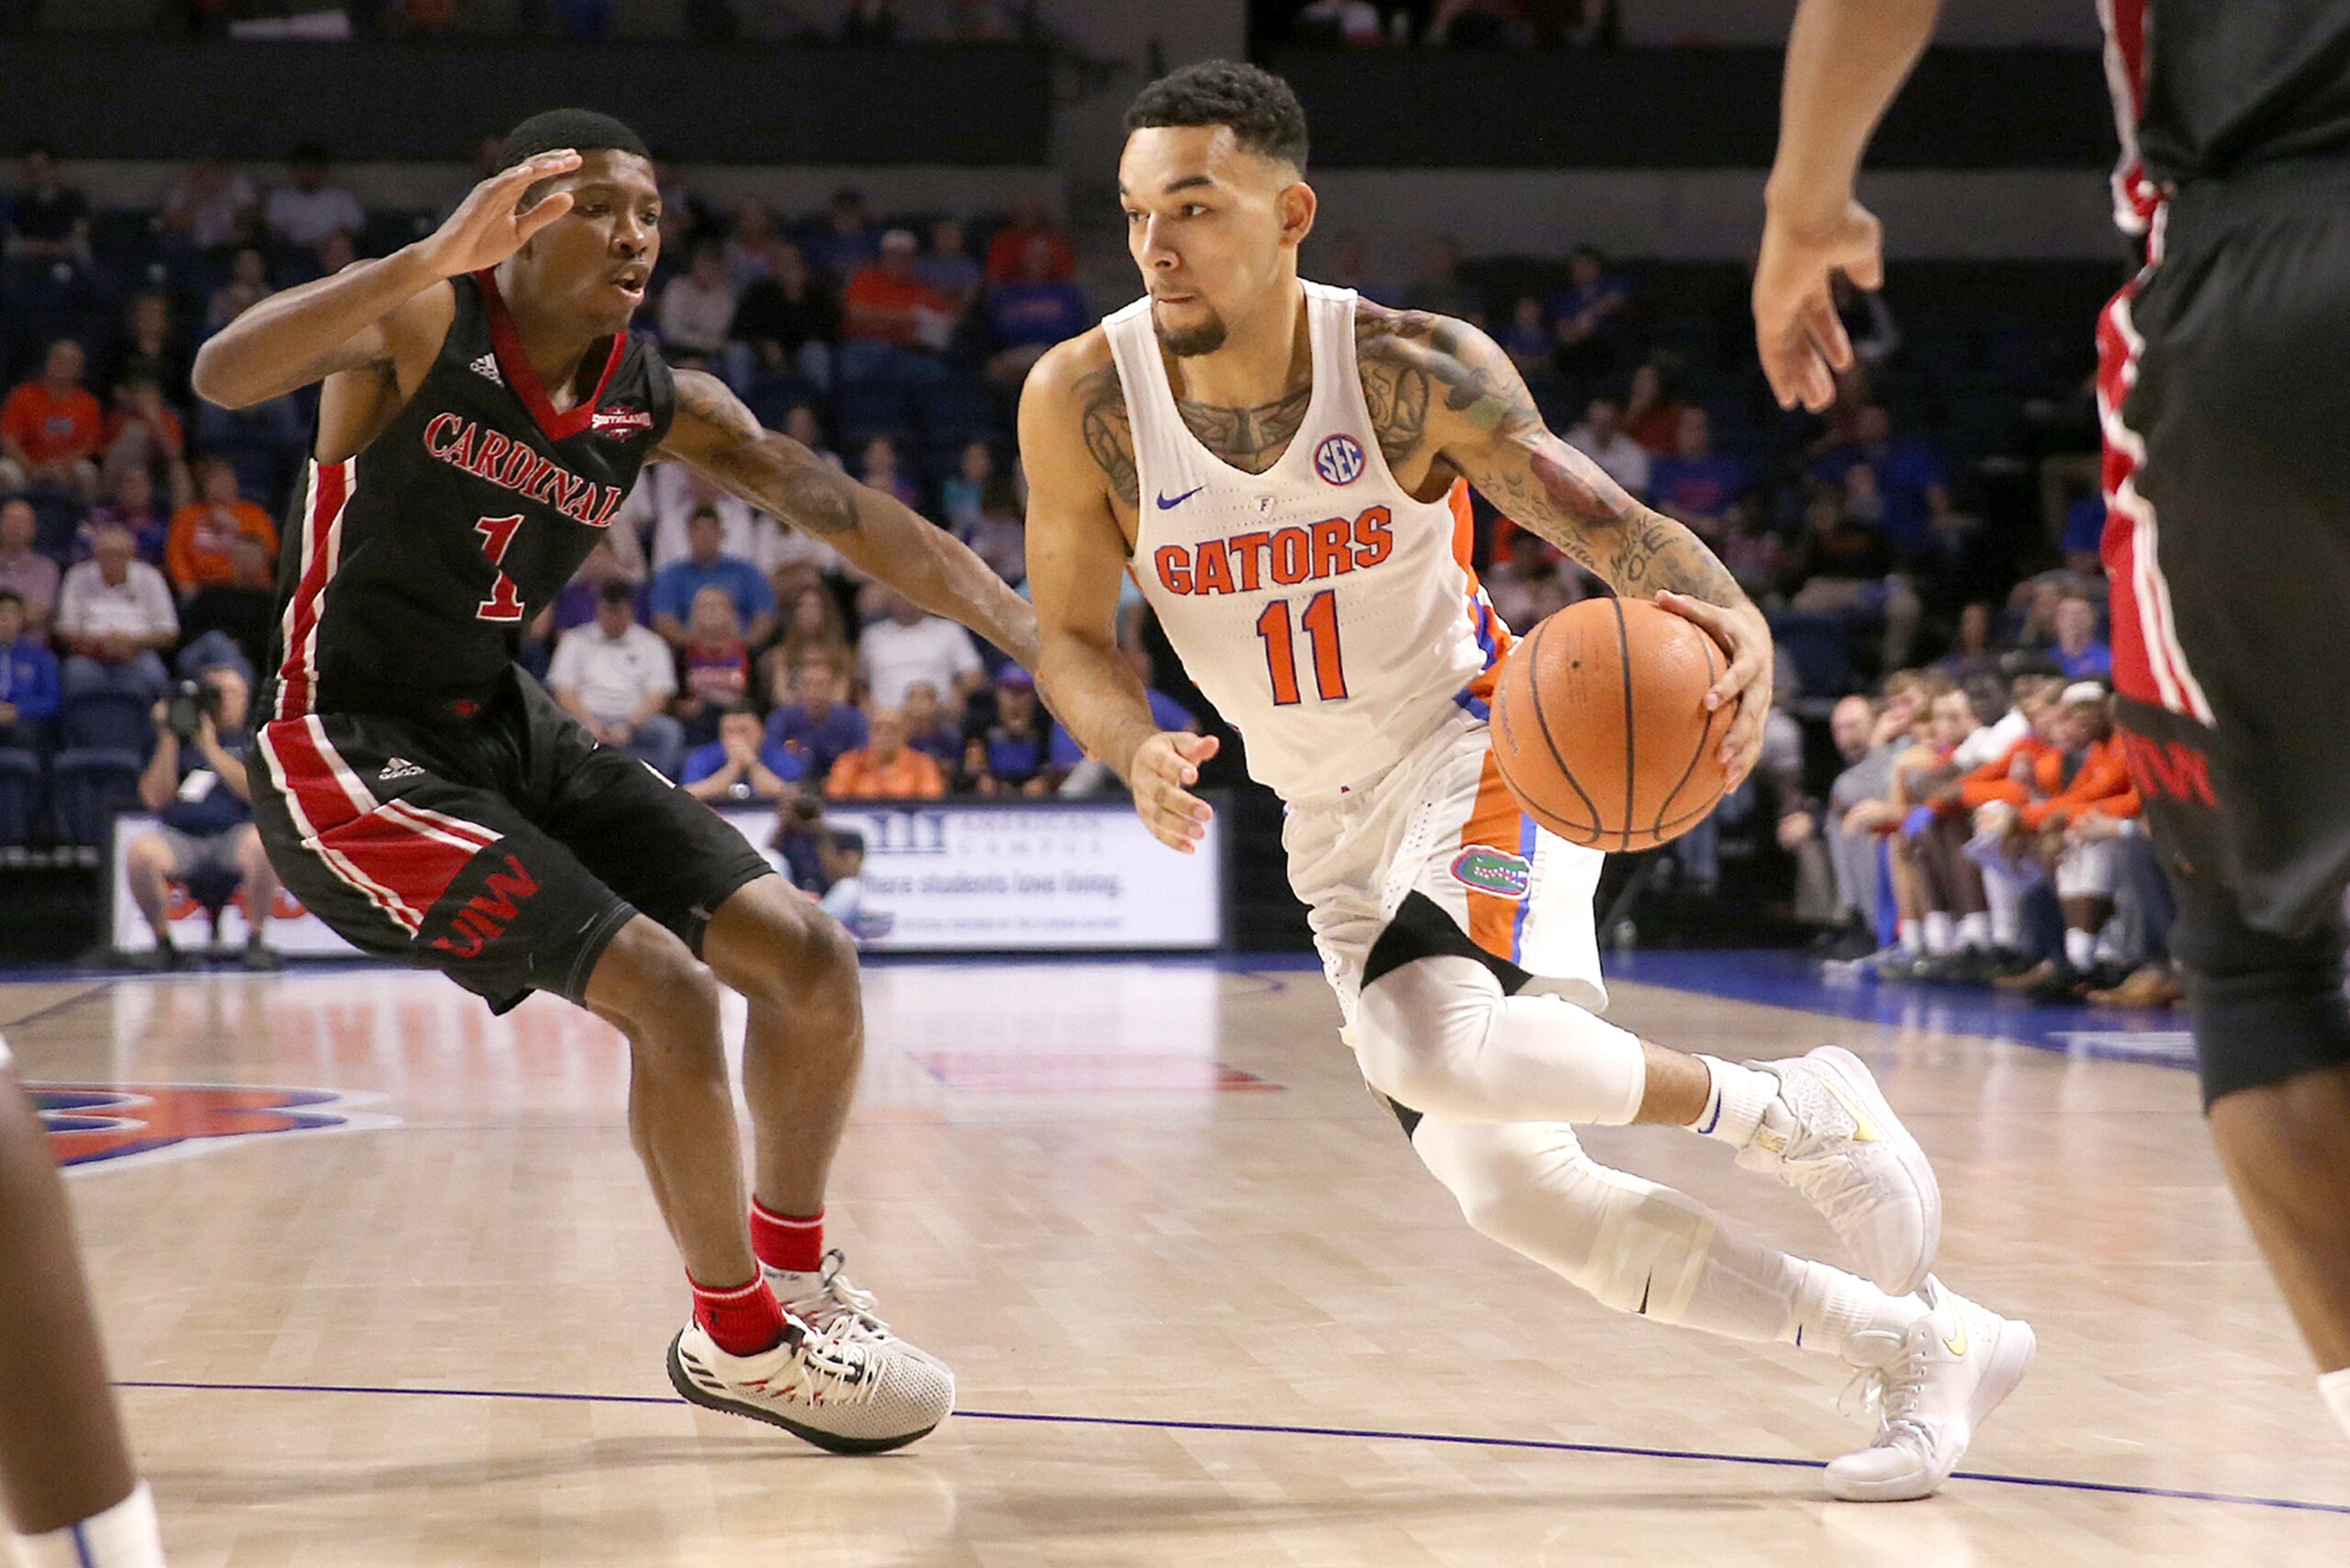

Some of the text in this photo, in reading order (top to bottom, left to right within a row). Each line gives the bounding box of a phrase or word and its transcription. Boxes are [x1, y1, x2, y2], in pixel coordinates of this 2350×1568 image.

[1259, 498, 1270, 511] F
[1317, 438, 1361, 483] SEC
[473, 513, 525, 622] 1
[1154, 505, 1393, 596] GATORS
[1256, 588, 1348, 706] 11
[378, 766, 426, 780] adidas
[431, 854, 540, 958] UIW
